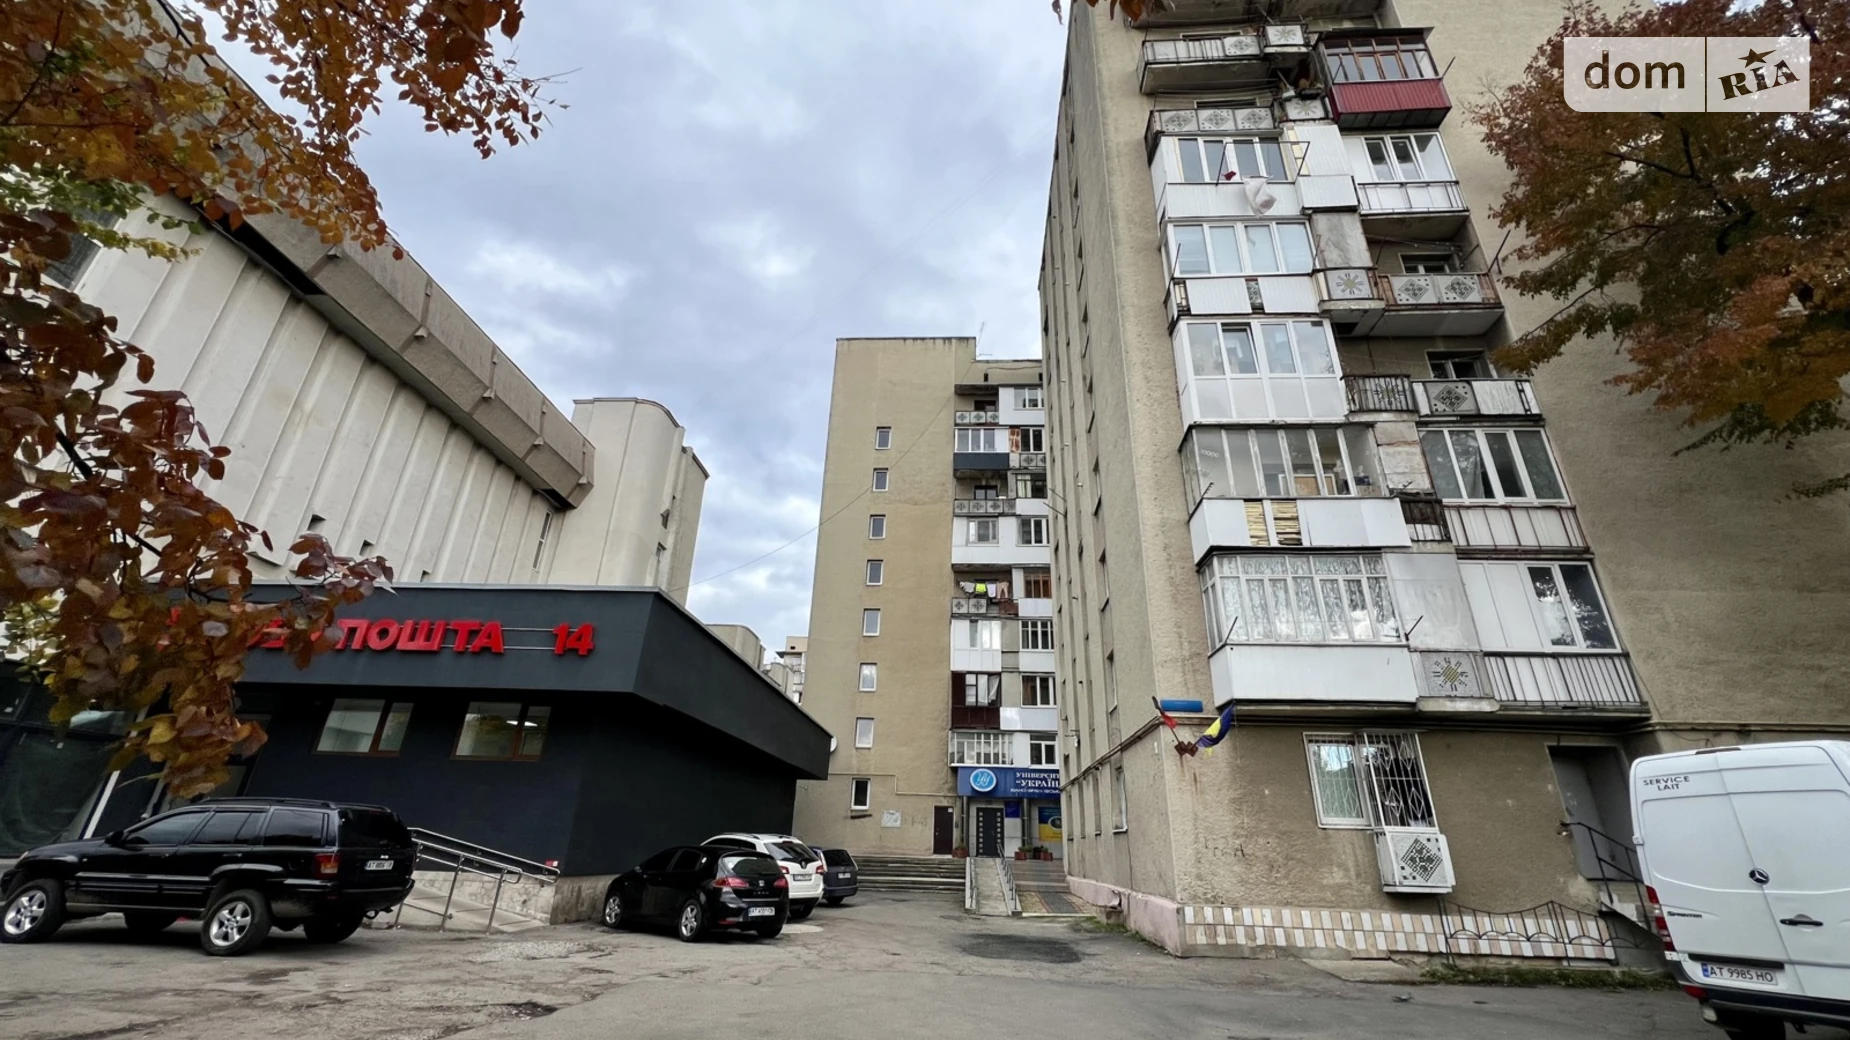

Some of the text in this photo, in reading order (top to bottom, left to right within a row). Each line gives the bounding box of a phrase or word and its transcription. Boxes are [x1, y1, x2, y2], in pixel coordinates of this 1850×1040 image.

[335, 618, 505, 654] ПОШТА
[552, 622, 596, 656] 14
[1643, 775, 1690, 786] SERVICE
[1657, 783, 1680, 791] LAIT
[1709, 966, 1774, 983] AT 9985 HO
